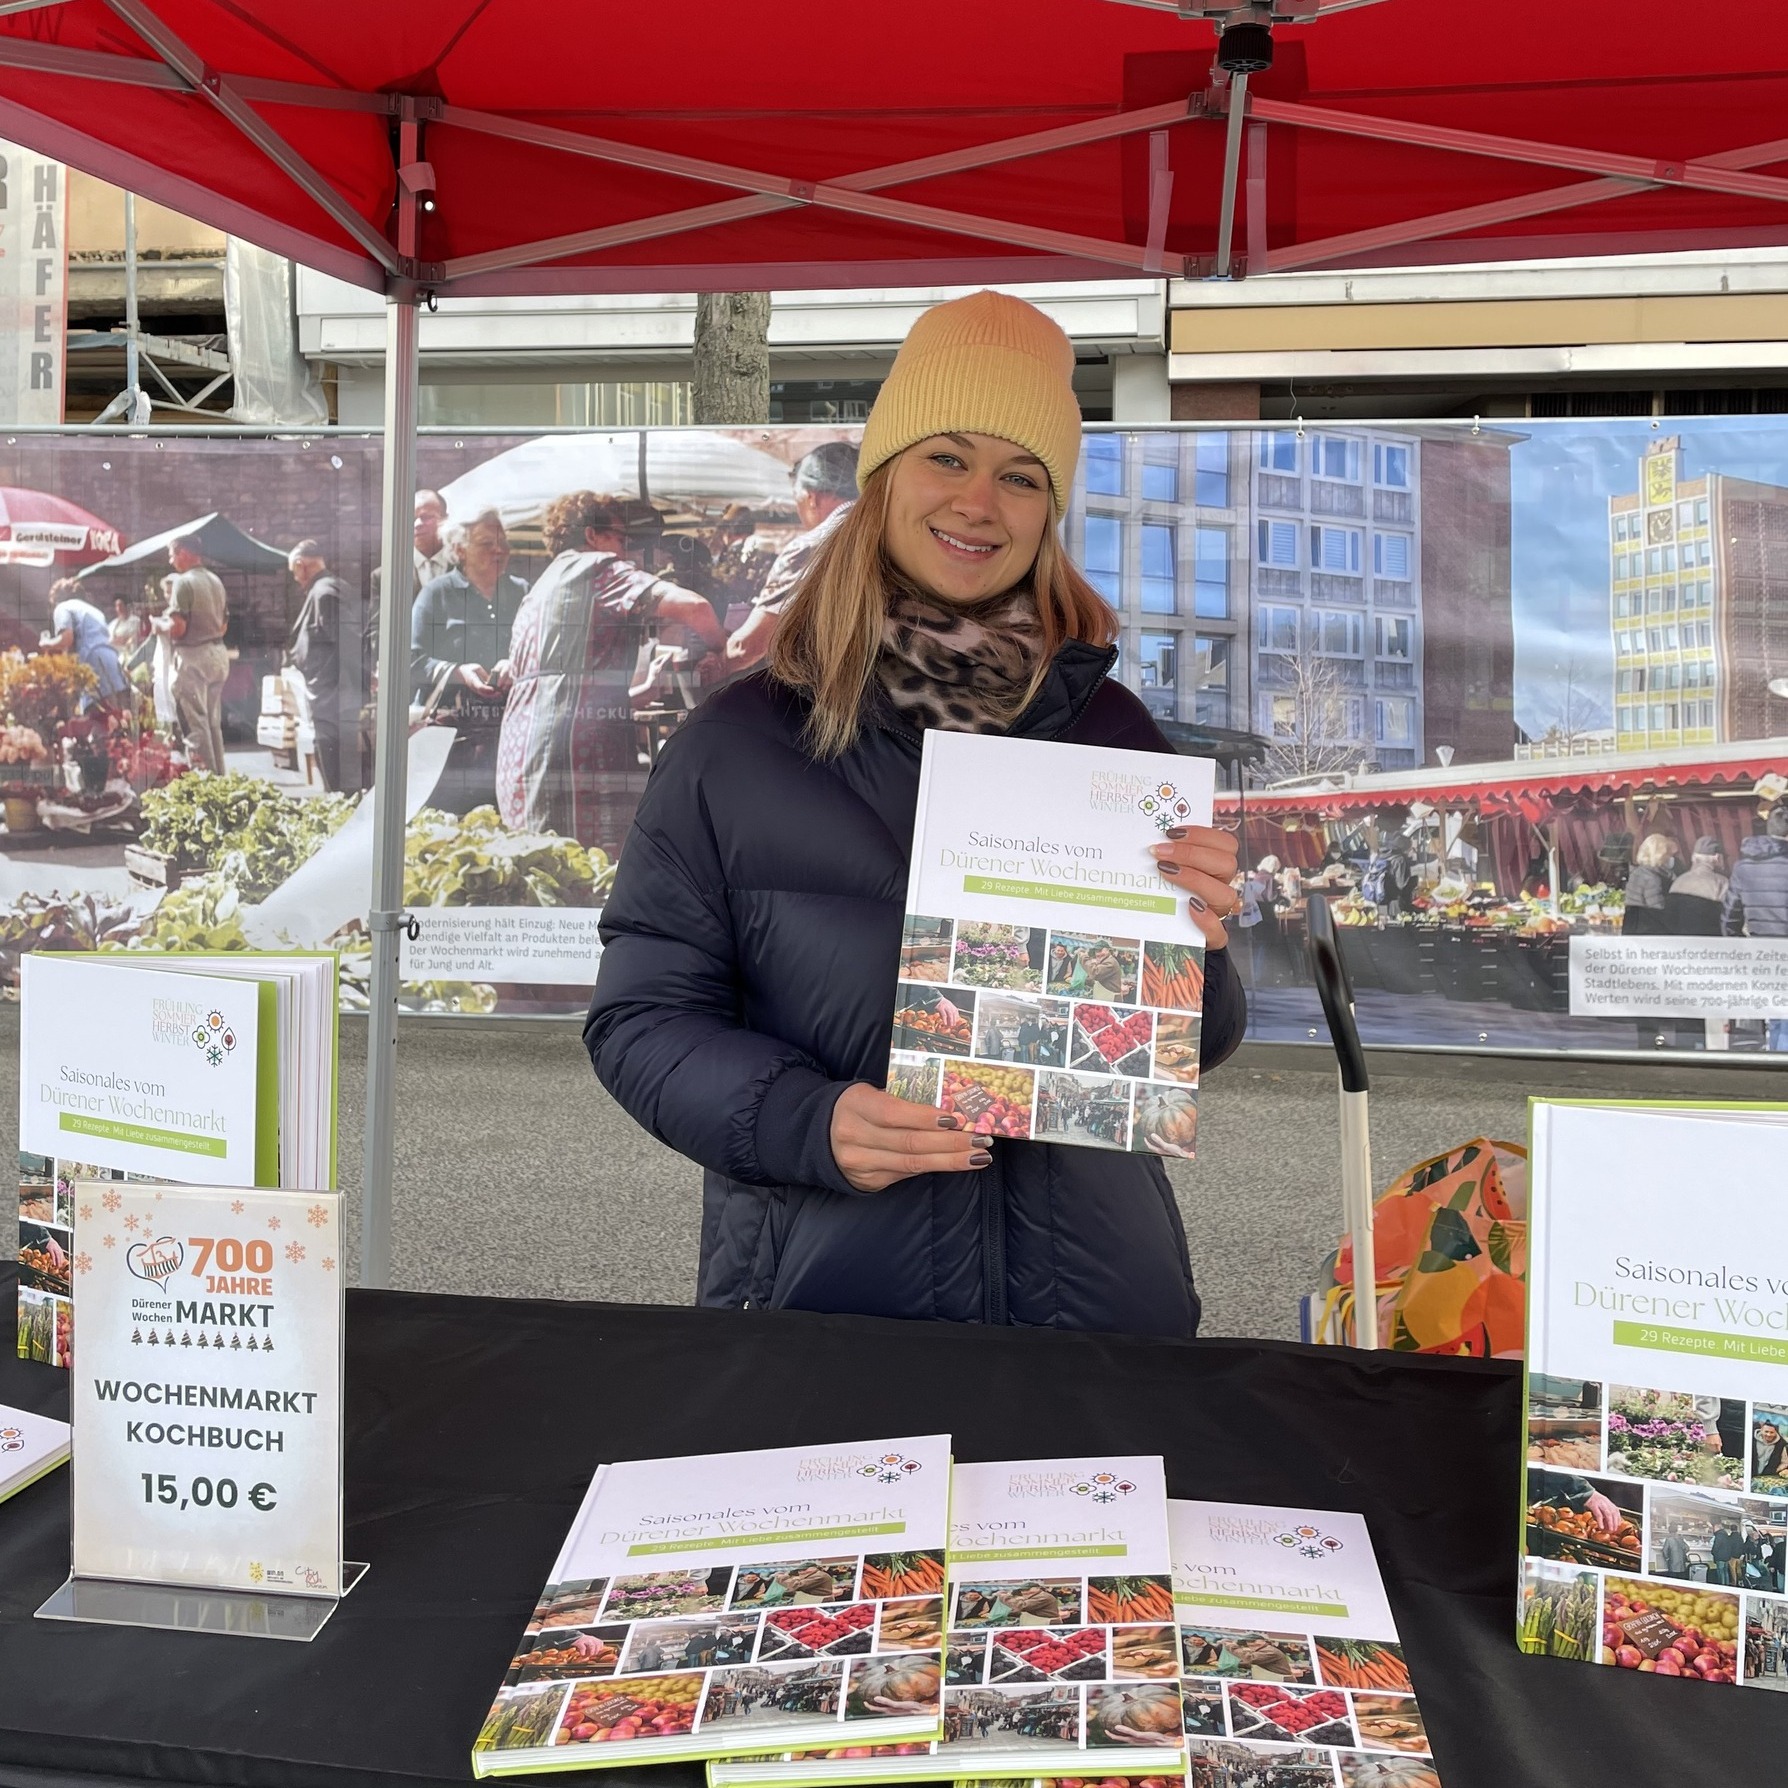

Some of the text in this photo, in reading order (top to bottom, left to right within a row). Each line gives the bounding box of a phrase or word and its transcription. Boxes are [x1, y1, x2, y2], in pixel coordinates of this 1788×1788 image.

[1090, 790, 1136, 803] HERBST
[1091, 781, 1143, 795] SOMMER
[1090, 800, 1134, 814] WINTER
[968, 831, 1103, 859] Saisonales vom
[940, 848, 1025, 874] Dürener
[981, 881, 993, 890] 29
[1035, 887, 1048, 896] Mit
[1051, 888, 1074, 899] Liebe
[419, 918, 491, 930] odernisierung
[495, 918, 516, 928] hält
[559, 919, 585, 930] Neue
[418, 932, 460, 944] bendige
[464, 932, 502, 942] Vielfalt
[505, 934, 518, 942] an
[522, 933, 575, 944] Produkten
[409, 945, 427, 955] Der
[431, 945, 503, 956] Wochenmarkt
[506, 946, 529, 957] wird
[532, 947, 591, 959] zunehmend
[1585, 948, 1622, 960] Selbst
[1626, 948, 1638, 959] in
[1641, 948, 1752, 961] herausfordernden
[409, 959, 424, 970] für
[428, 959, 452, 972] Jung
[456, 960, 475, 970] und
[1585, 963, 1606, 974] der
[1610, 964, 1658, 975] Dürener
[1661, 964, 1748, 976] Wochenmarkt
[1752, 965, 1771, 976] ein
[1584, 978, 1660, 990] Stadtlebens.
[1664, 979, 1683, 990] Mit
[1687, 979, 1748, 991] modernen
[153, 998, 203, 1015] FRÜHLING
[1585, 992, 1629, 1004] Werten
[1633, 994, 1661, 1004] wird
[1665, 995, 1697, 1006] seine
[1700, 994, 1769, 1009] 700-jährige
[152, 1010, 196, 1025] SOMMER
[153, 1020, 190, 1035] HERBST
[152, 1031, 189, 1046] WINTER
[60, 1065, 165, 1097] Saisonales vom
[40, 1083, 227, 1133] Dürener Wochenmarkt
[72, 1119, 82, 1128] 29
[113, 1126, 124, 1136] Mit
[126, 1128, 144, 1139] Liebe
[188, 1237, 273, 1277] 700
[1615, 1256, 1758, 1293] Saisonales
[206, 1275, 273, 1296] JAHRE
[132, 1298, 172, 1309] Dürener
[1574, 1281, 1705, 1320] Dürener
[132, 1300, 274, 1328] Wochen MARKT
[1640, 1329, 1658, 1342] 29
[1724, 1339, 1746, 1353] Mit
[1750, 1342, 1786, 1358] Liebe
[94, 1379, 318, 1414] WOCHENMARKT
[126, 1421, 284, 1452] KOCHBUCH
[141, 1472, 278, 1511] 15,00 €
[639, 1503, 811, 1526] Saisonales vom
[600, 1506, 907, 1545] Dürener Wochenmarkt
[977, 1521, 1026, 1530] vom
[721, 1538, 739, 1546] Mit
[742, 1535, 772, 1544] Liebe
[951, 1528, 1126, 1547] ochenmarkt
[960, 1552, 990, 1560] Liebe
[1184, 1563, 1237, 1575] vom
[1173, 1575, 1345, 1600] ochenmarkt
[1175, 1594, 1205, 1603] Liebe
